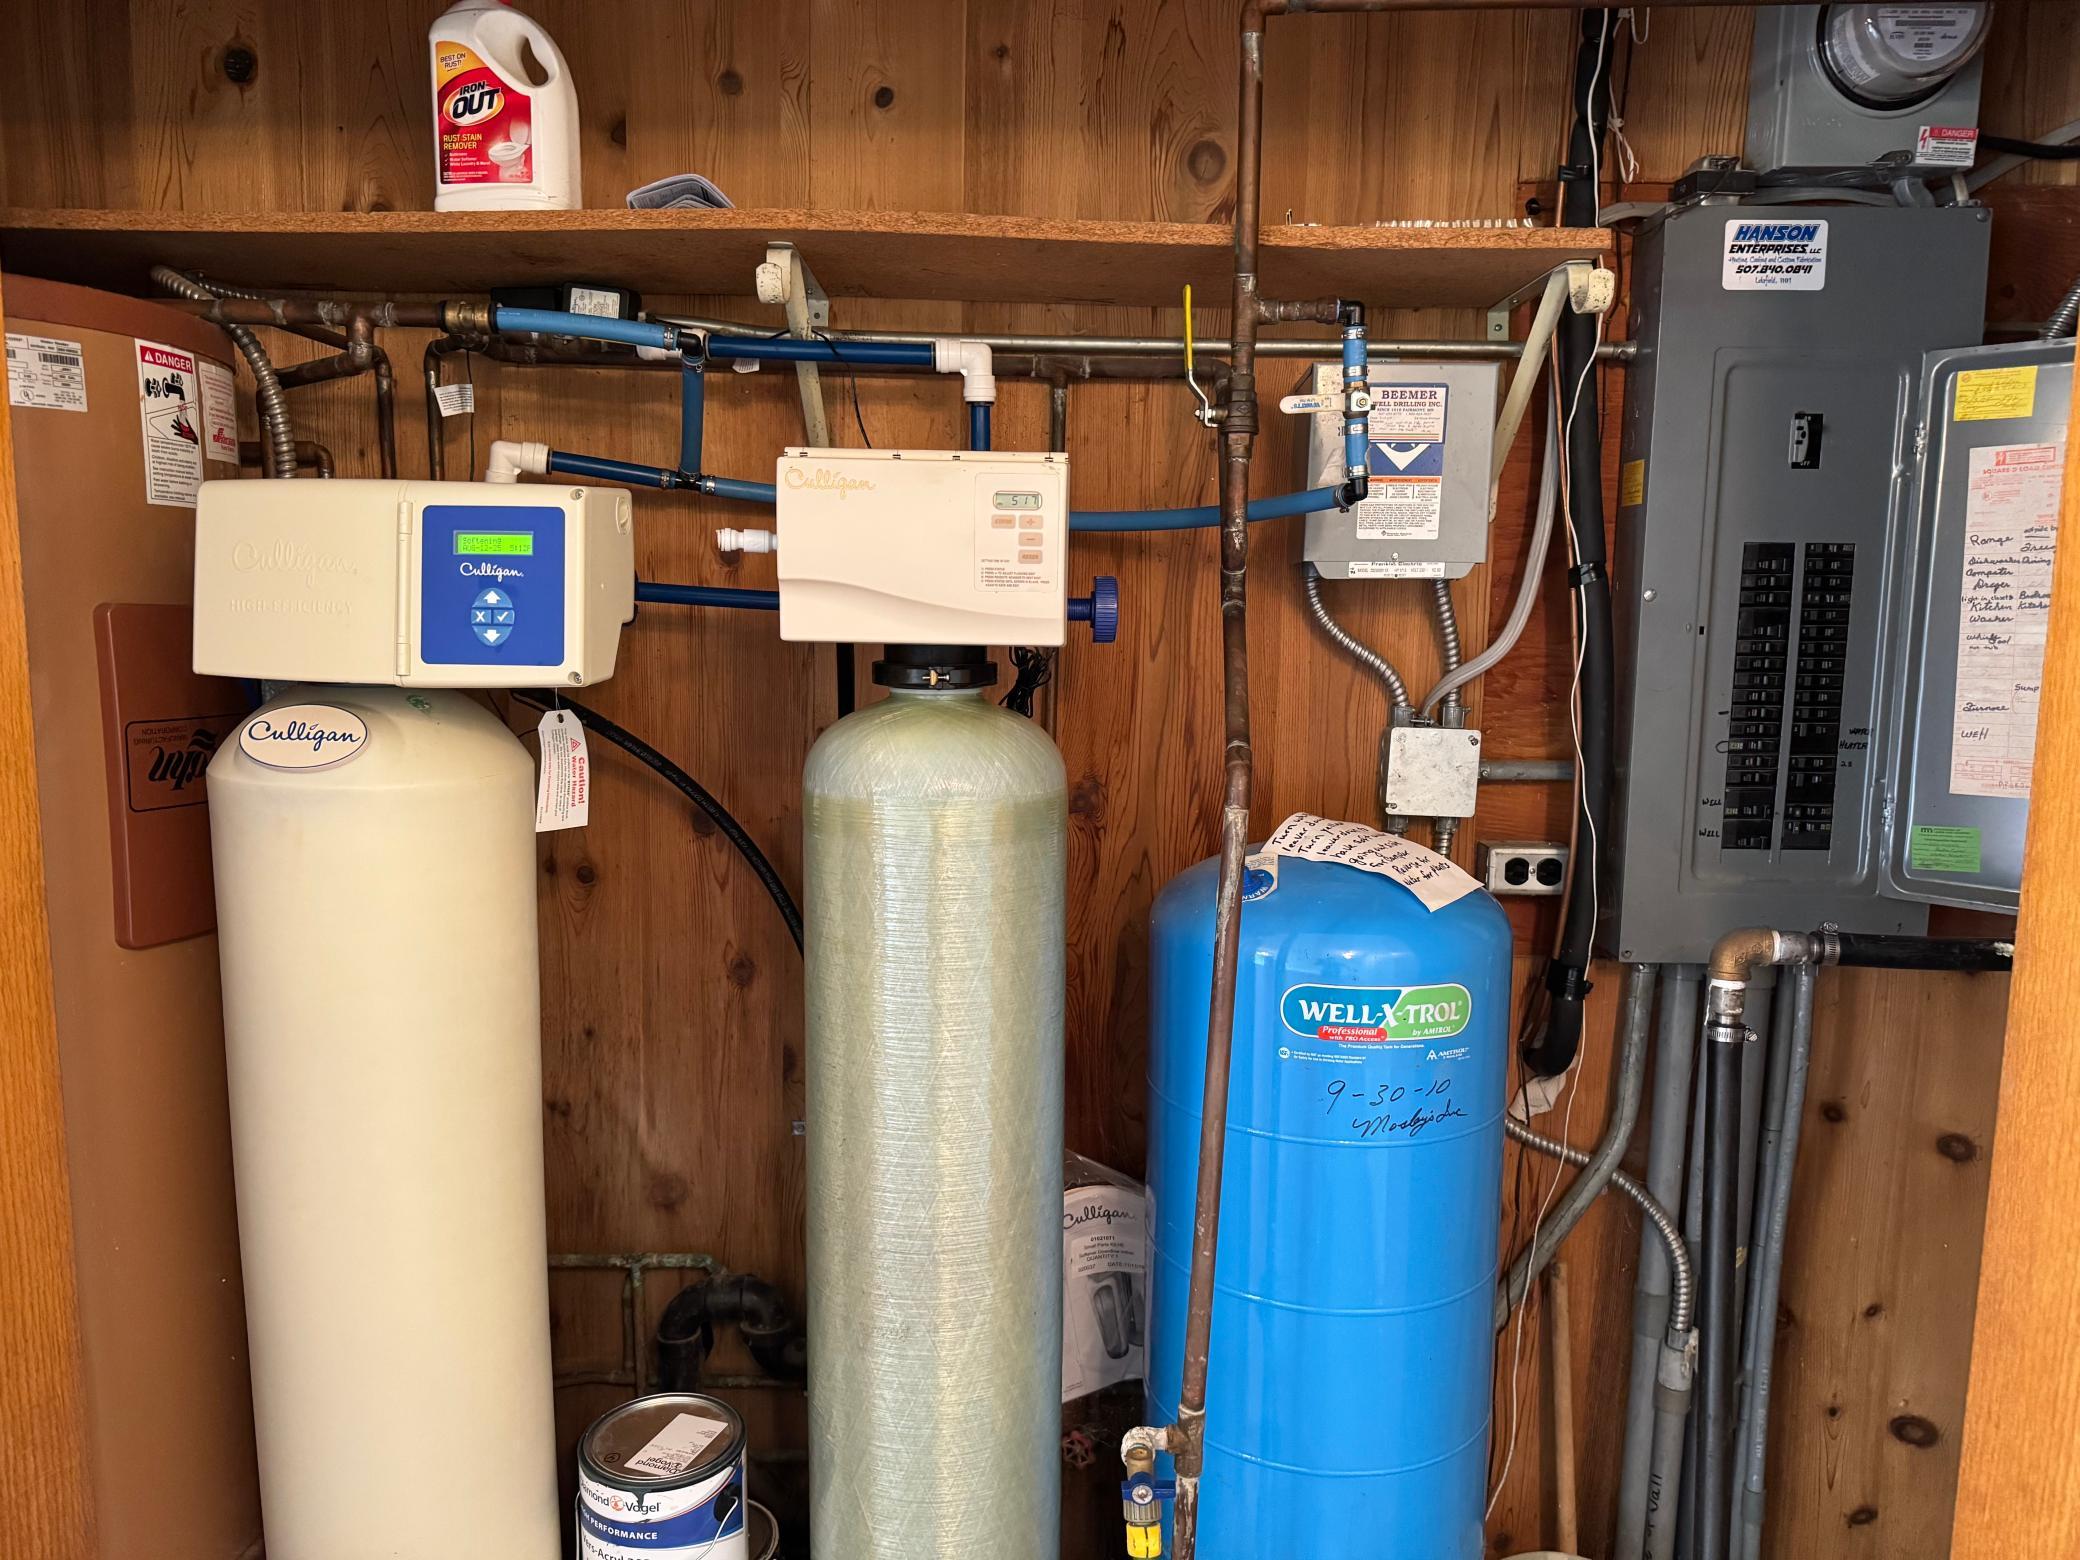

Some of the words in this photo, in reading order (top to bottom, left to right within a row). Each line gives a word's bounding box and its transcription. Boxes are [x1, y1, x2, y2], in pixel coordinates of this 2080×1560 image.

[440, 54, 455, 63] BEST
[456, 52, 466, 60] ON
[444, 60, 462, 69] RUST!
[452, 87, 501, 119] OUT
[443, 134, 461, 142] RUST
[462, 133, 482, 142] STAIN
[1942, 128, 1974, 138] DANGER
[443, 141, 477, 150] REMOVER
[1732, 224, 1821, 242] HANSON
[1735, 264, 1813, 274] 507.840.0841
[155, 352, 192, 372] DANGER
[1381, 390, 1438, 400] BEEMER
[784, 468, 876, 499] Culligan
[463, 537, 502, 545] Softening
[1969, 534, 2014, 547] Range
[460, 562, 524, 582] Culligan
[1968, 600, 2013, 612] Kitchen
[248, 721, 361, 751] Culligan
[578, 756, 586, 805] Caution!
[1702, 798, 1722, 806] WELL
[1271, 823, 1298, 845] Turn
[1699, 829, 1721, 838] WELL
[1297, 834, 1325, 854] Turn
[1298, 998, 1461, 1028] WELL-X-TROL
[1322, 1025, 1378, 1036] Professional
[1412, 1028, 1421, 1037] by
[1063, 1205, 1137, 1230] Culligan
[634, 1458, 682, 1475] Diamond
[625, 1502, 660, 1516] Vogel
[590, 1517, 658, 1541] PERFORMANCE
